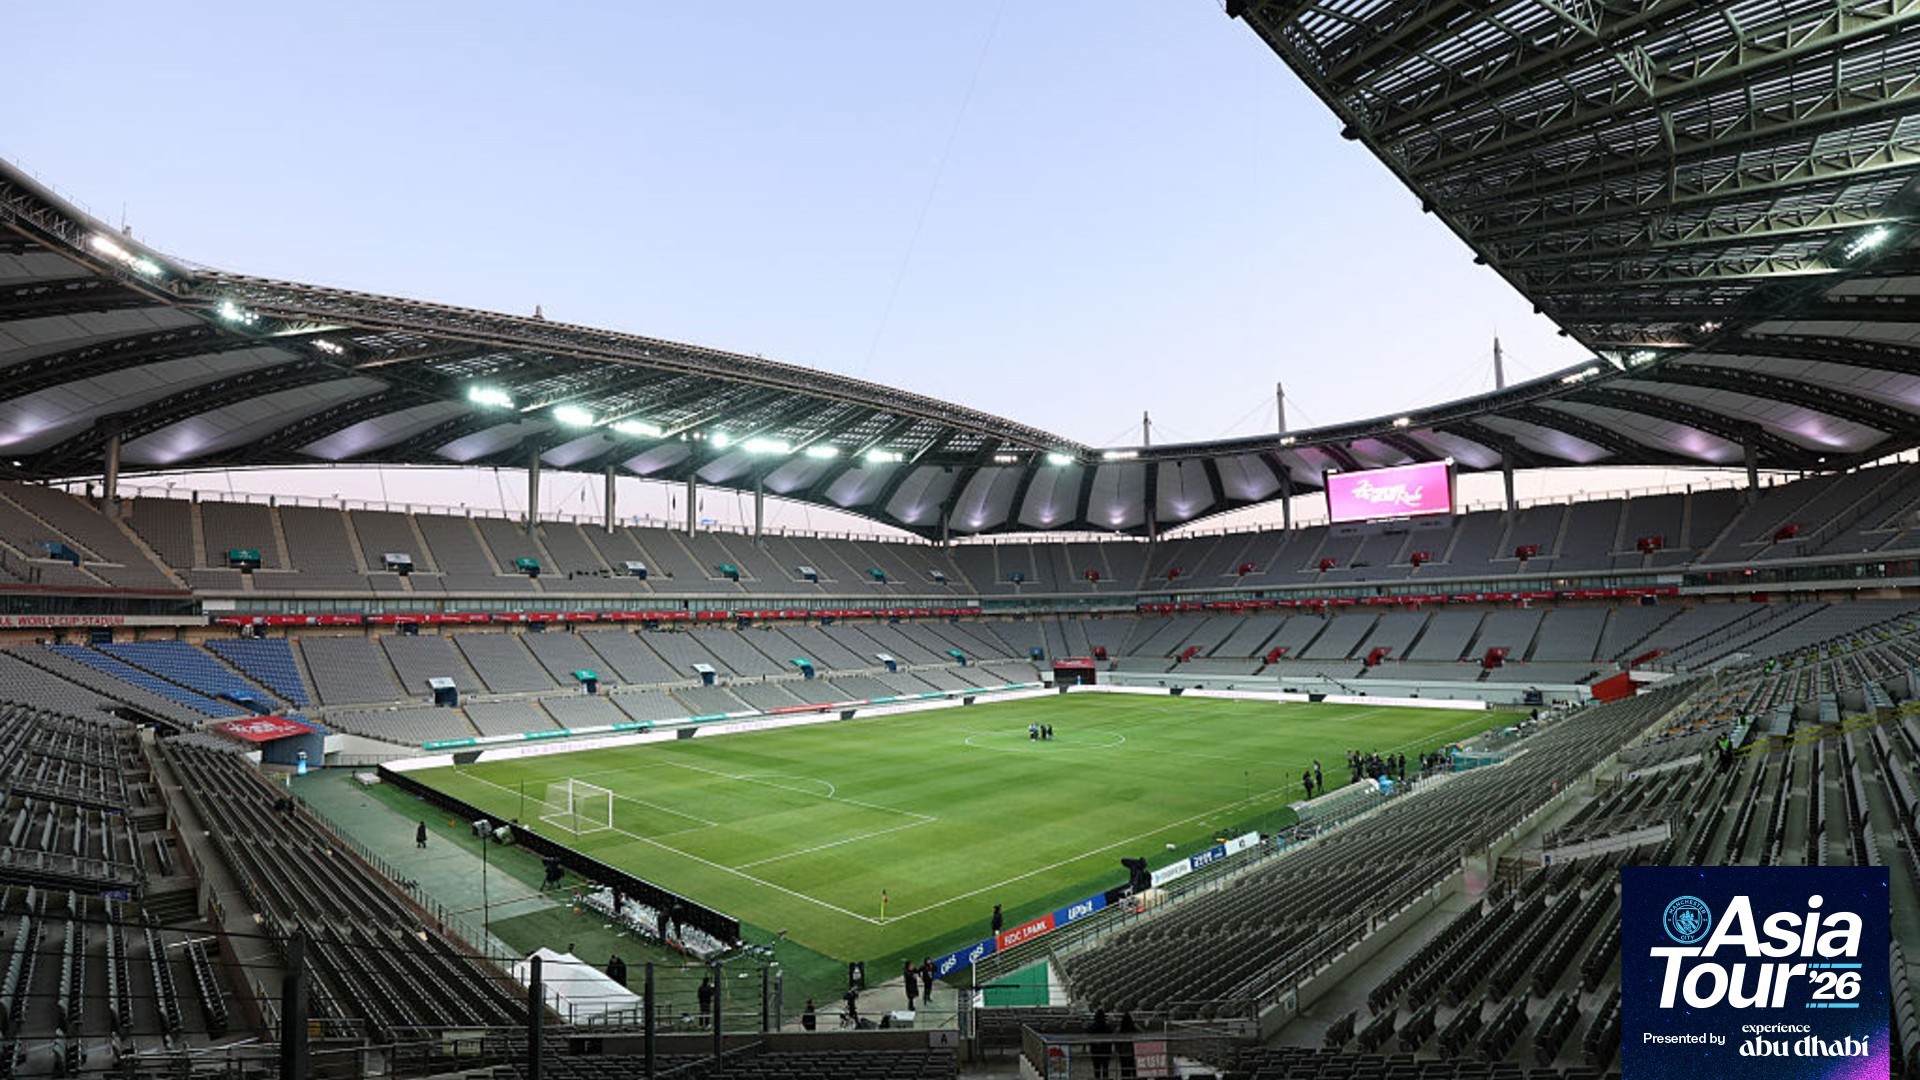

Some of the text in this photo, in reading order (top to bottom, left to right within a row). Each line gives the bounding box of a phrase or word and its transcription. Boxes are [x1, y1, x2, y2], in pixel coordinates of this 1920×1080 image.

[18, 616, 55, 625] WORLD
[59, 616, 79, 625] CUP
[82, 616, 124, 625] STADIUM
